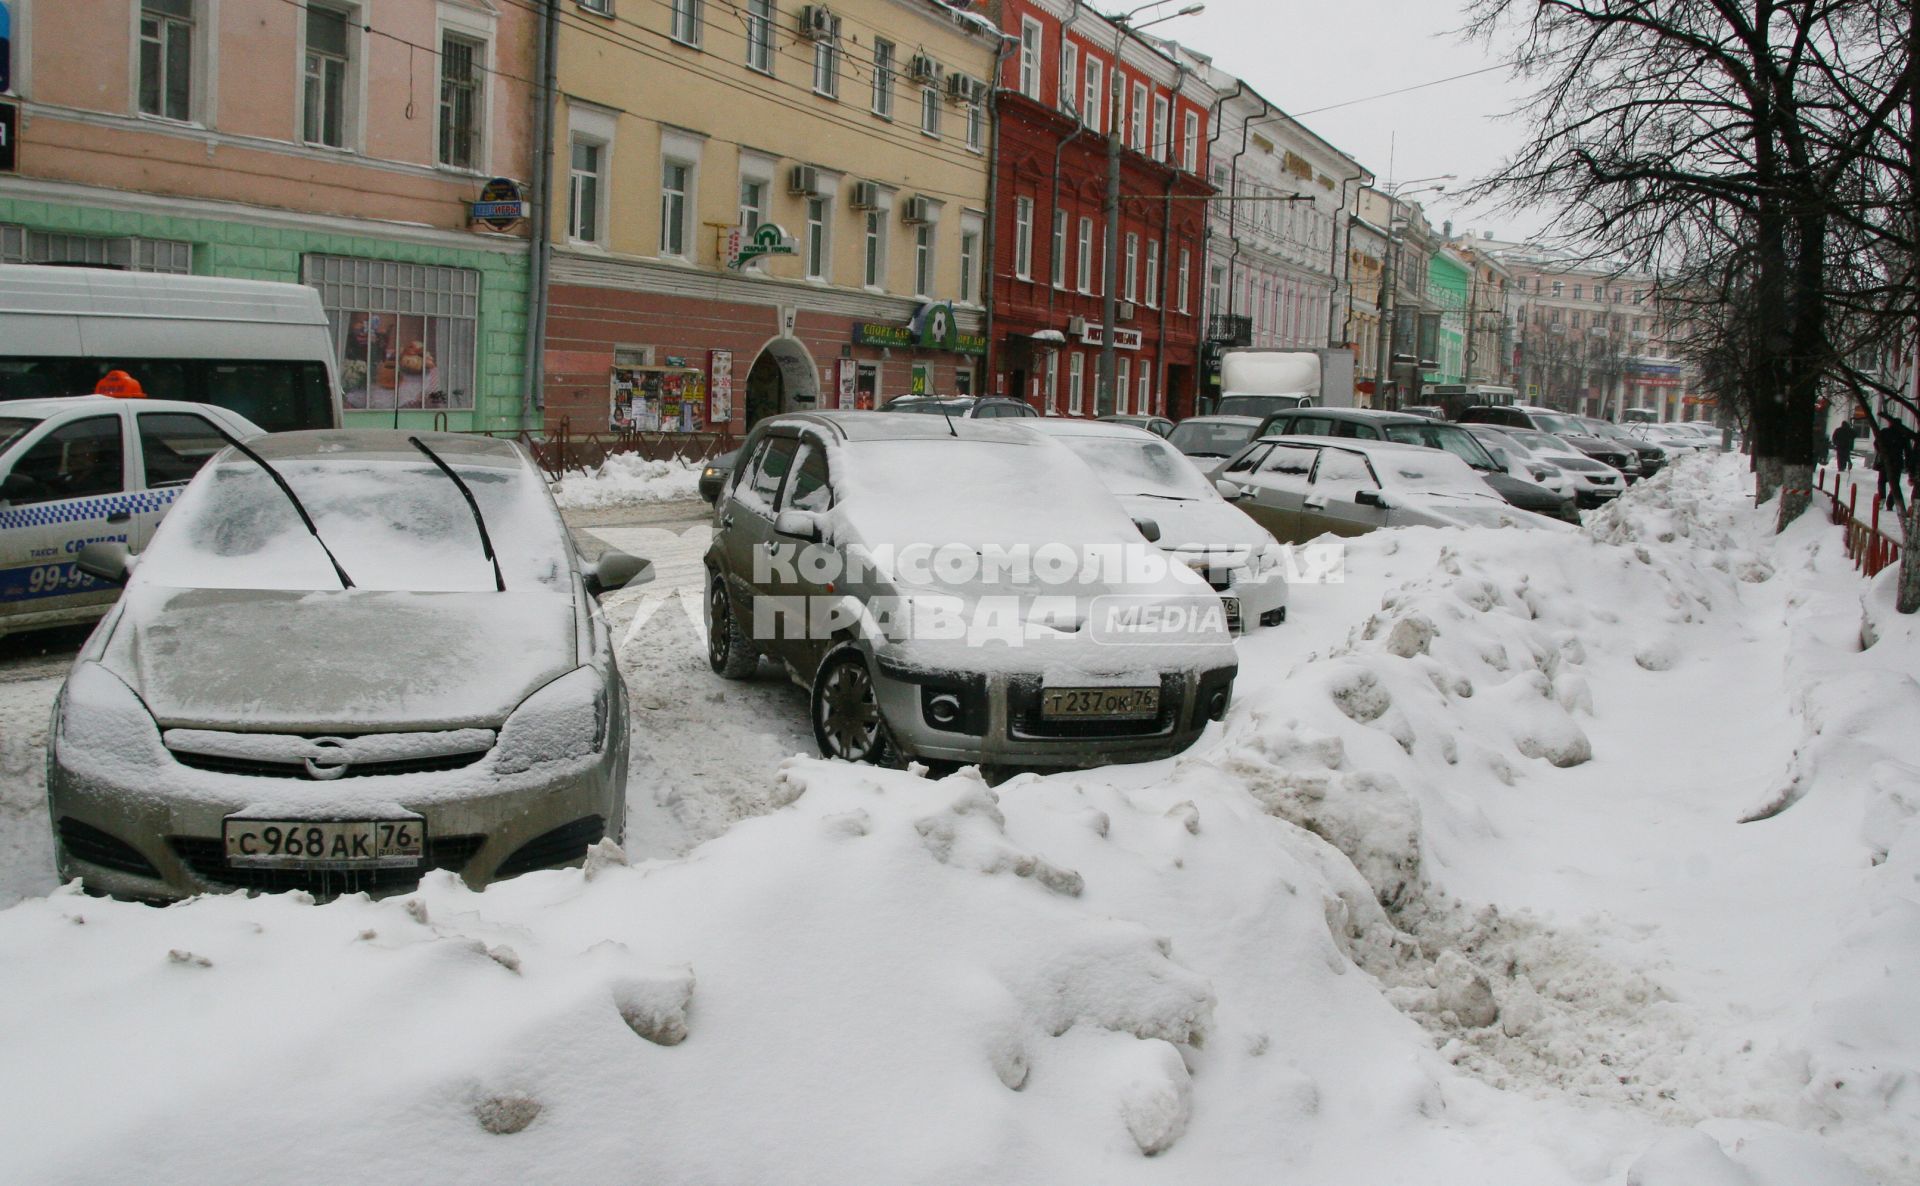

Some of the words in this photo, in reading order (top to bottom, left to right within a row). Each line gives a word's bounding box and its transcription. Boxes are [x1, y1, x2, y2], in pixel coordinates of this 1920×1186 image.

[863, 323, 890, 337] СПОРТ
[913, 376, 924, 392] 24
[30, 547, 58, 557] ТАКСИ
[1135, 690, 1151, 706] 76
[239, 826, 369, 857] С968АК
[380, 824, 412, 848] 76
